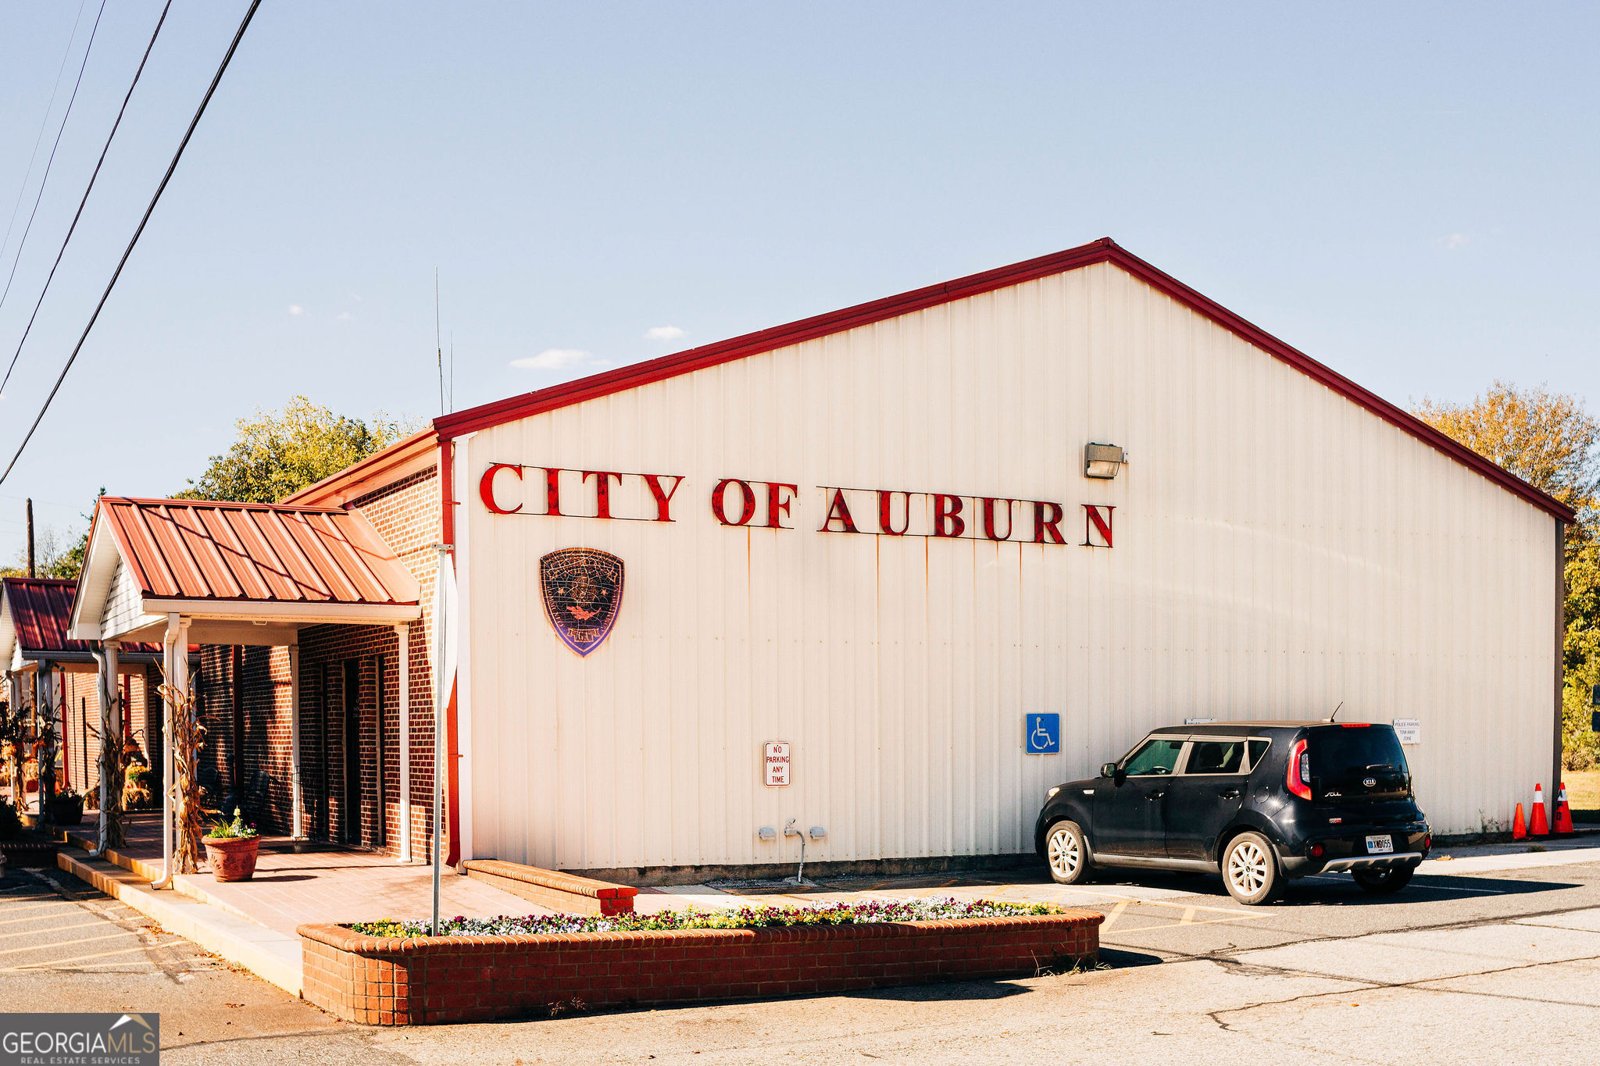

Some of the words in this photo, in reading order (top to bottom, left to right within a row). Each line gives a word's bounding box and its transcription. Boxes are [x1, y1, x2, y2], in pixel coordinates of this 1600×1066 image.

[480, 462, 685, 522] CITY
[711, 479, 798, 528] OF
[820, 487, 1117, 548] AUBURN
[772, 775, 785, 783] TIME
